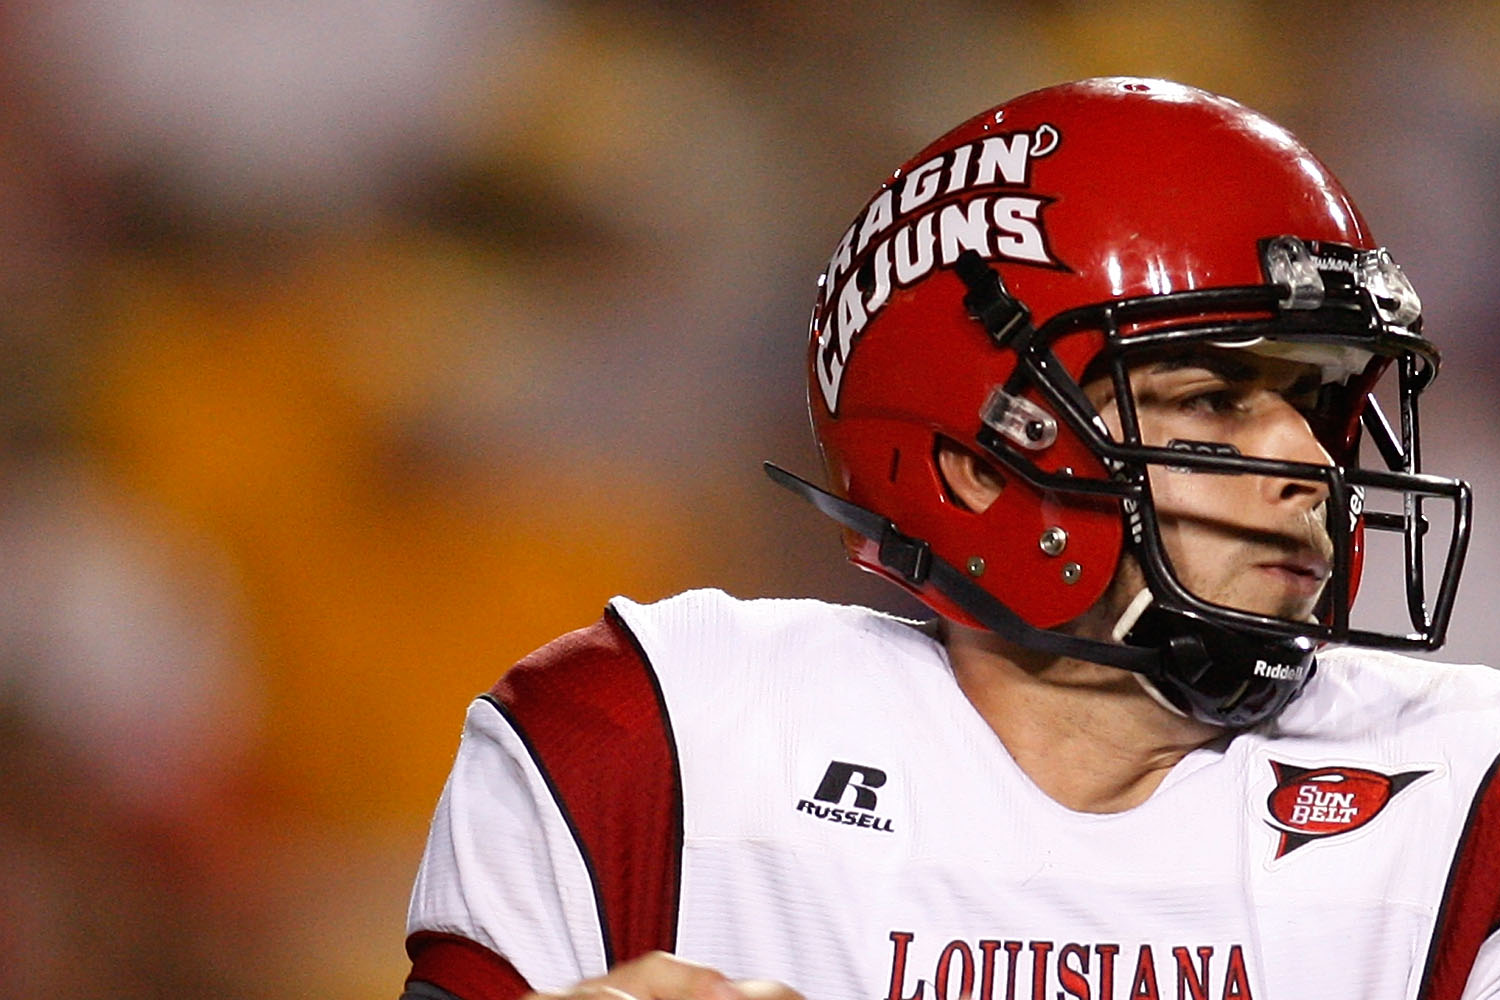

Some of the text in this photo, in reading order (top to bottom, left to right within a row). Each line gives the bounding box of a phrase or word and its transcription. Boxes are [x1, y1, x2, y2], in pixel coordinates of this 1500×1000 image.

[817, 197, 1050, 413] CAJUNS
[813, 760, 888, 810] R
[1297, 785, 1355, 810] SUN
[797, 799, 894, 833] RUSSELL
[1291, 803, 1358, 824] BELT
